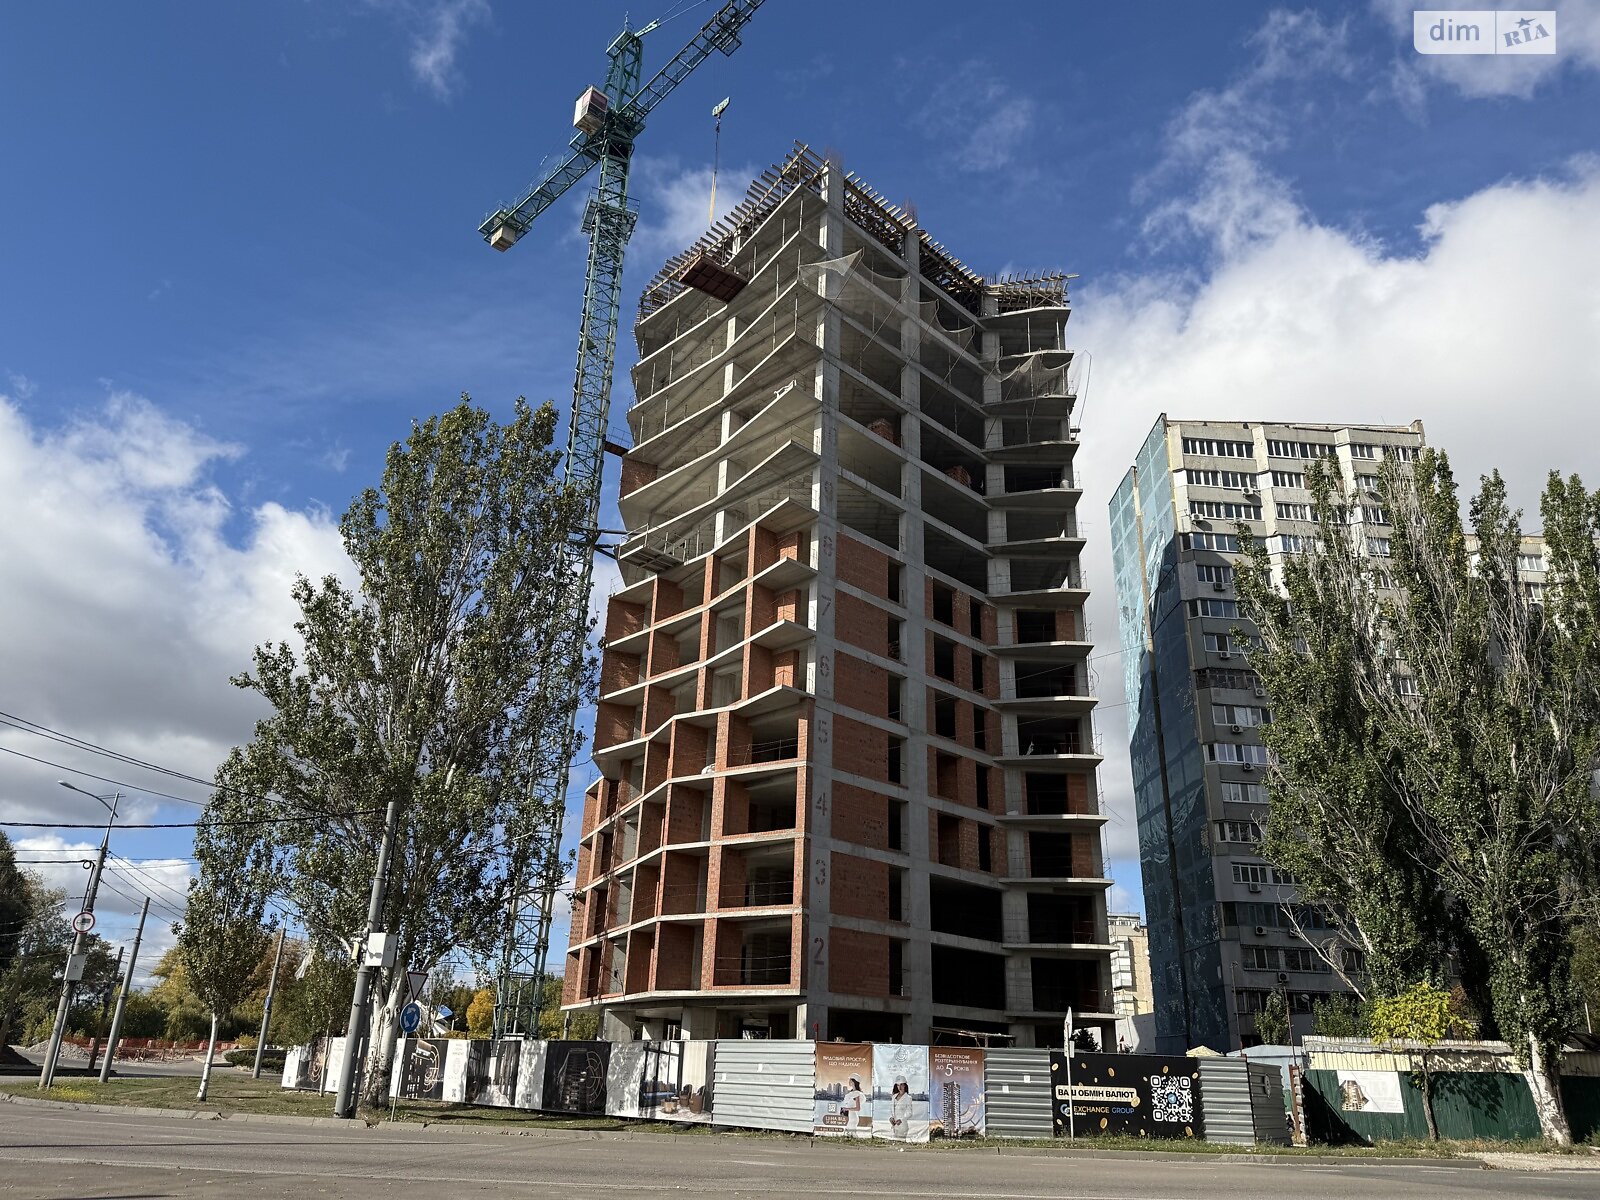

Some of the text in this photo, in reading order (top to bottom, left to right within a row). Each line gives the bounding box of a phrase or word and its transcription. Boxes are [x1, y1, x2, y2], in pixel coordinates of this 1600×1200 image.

[821, 594, 831, 616] 7
[820, 655, 830, 678] 6
[818, 719, 828, 744] 5
[815, 792, 828, 816] 4
[815, 859, 826, 885] 3
[814, 937, 825, 965] 2
[944, 1063, 953, 1077] 5
[1078, 1089, 1104, 1097] ОБМІН
[1105, 1090, 1135, 1098] ВАЛЮТ
[1073, 1105, 1110, 1113] EXCHANGE
